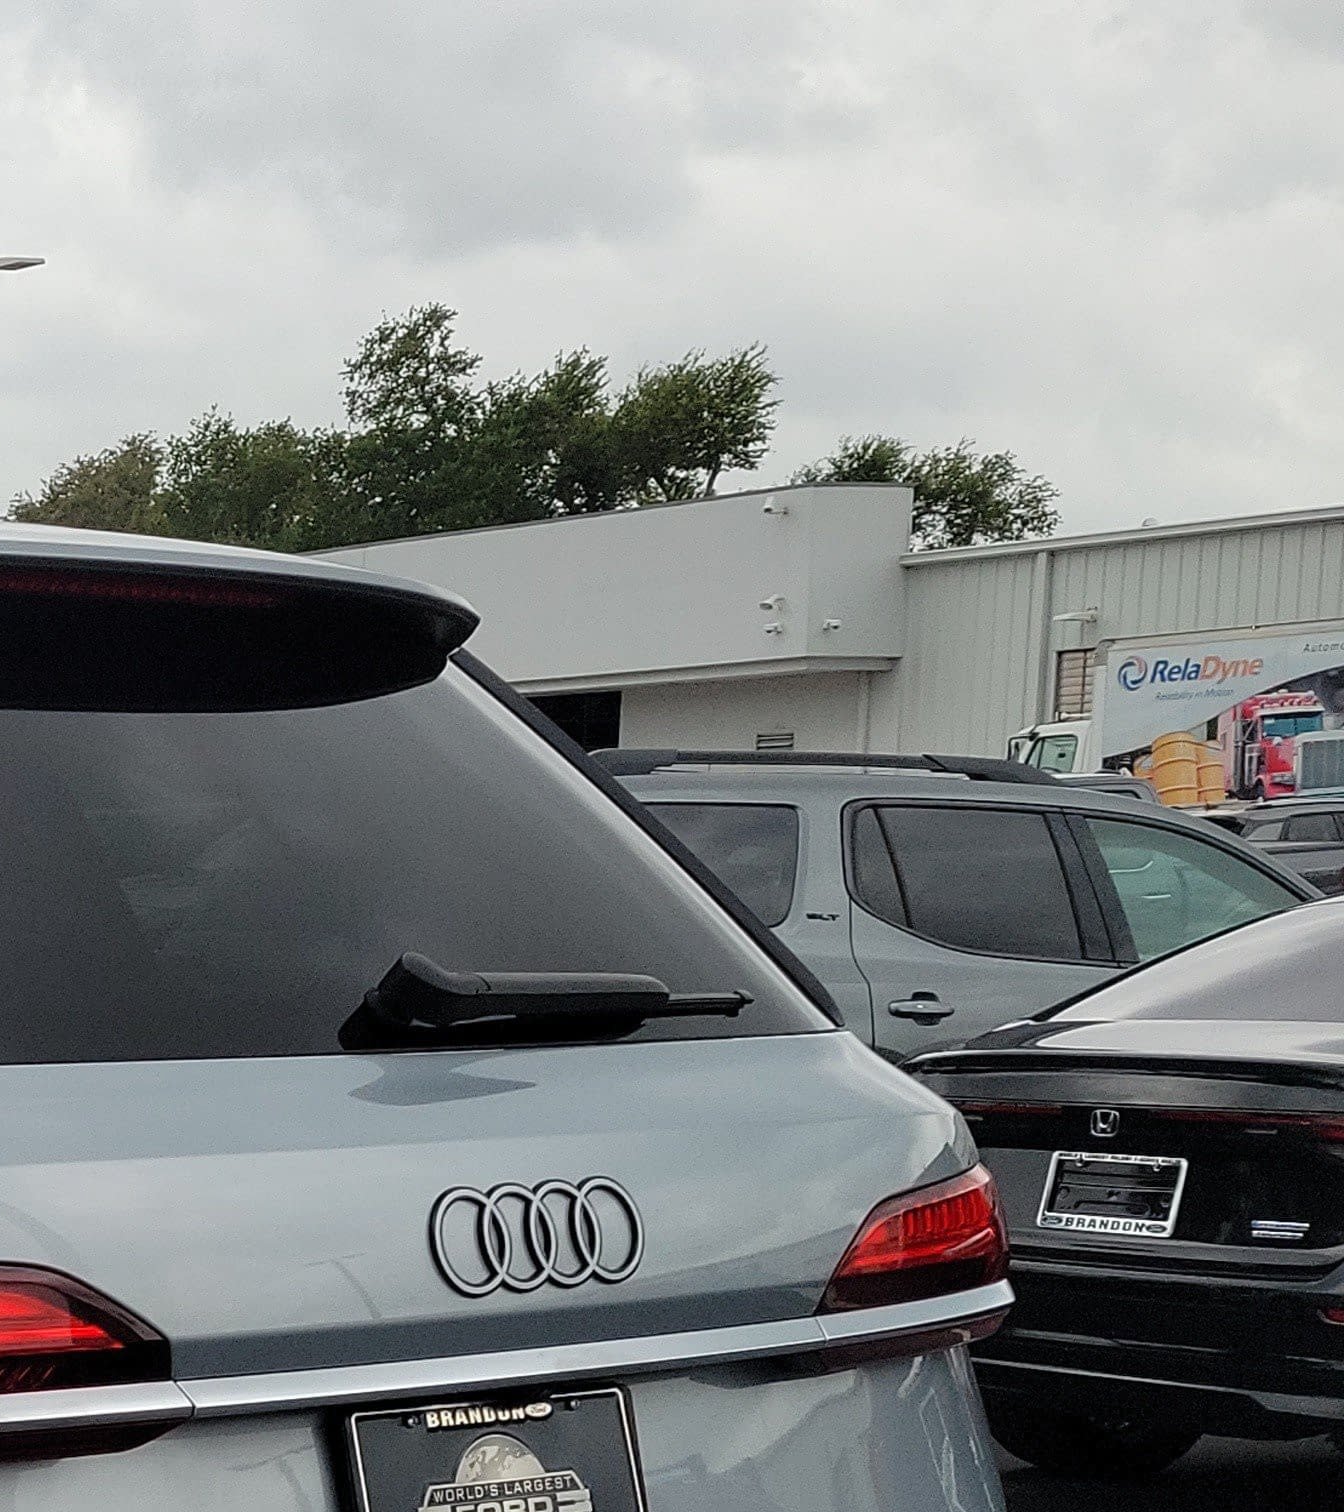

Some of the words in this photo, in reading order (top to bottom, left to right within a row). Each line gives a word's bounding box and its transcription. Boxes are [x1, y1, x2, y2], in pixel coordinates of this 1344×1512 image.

[1150, 656, 1263, 684] RelaDyne
[1064, 1217, 1146, 1233] BRANDON
[426, 1406, 525, 1428] BRANDON
[433, 1485, 498, 1503] WORLD'S
[504, 1476, 572, 1496] LARGEST
